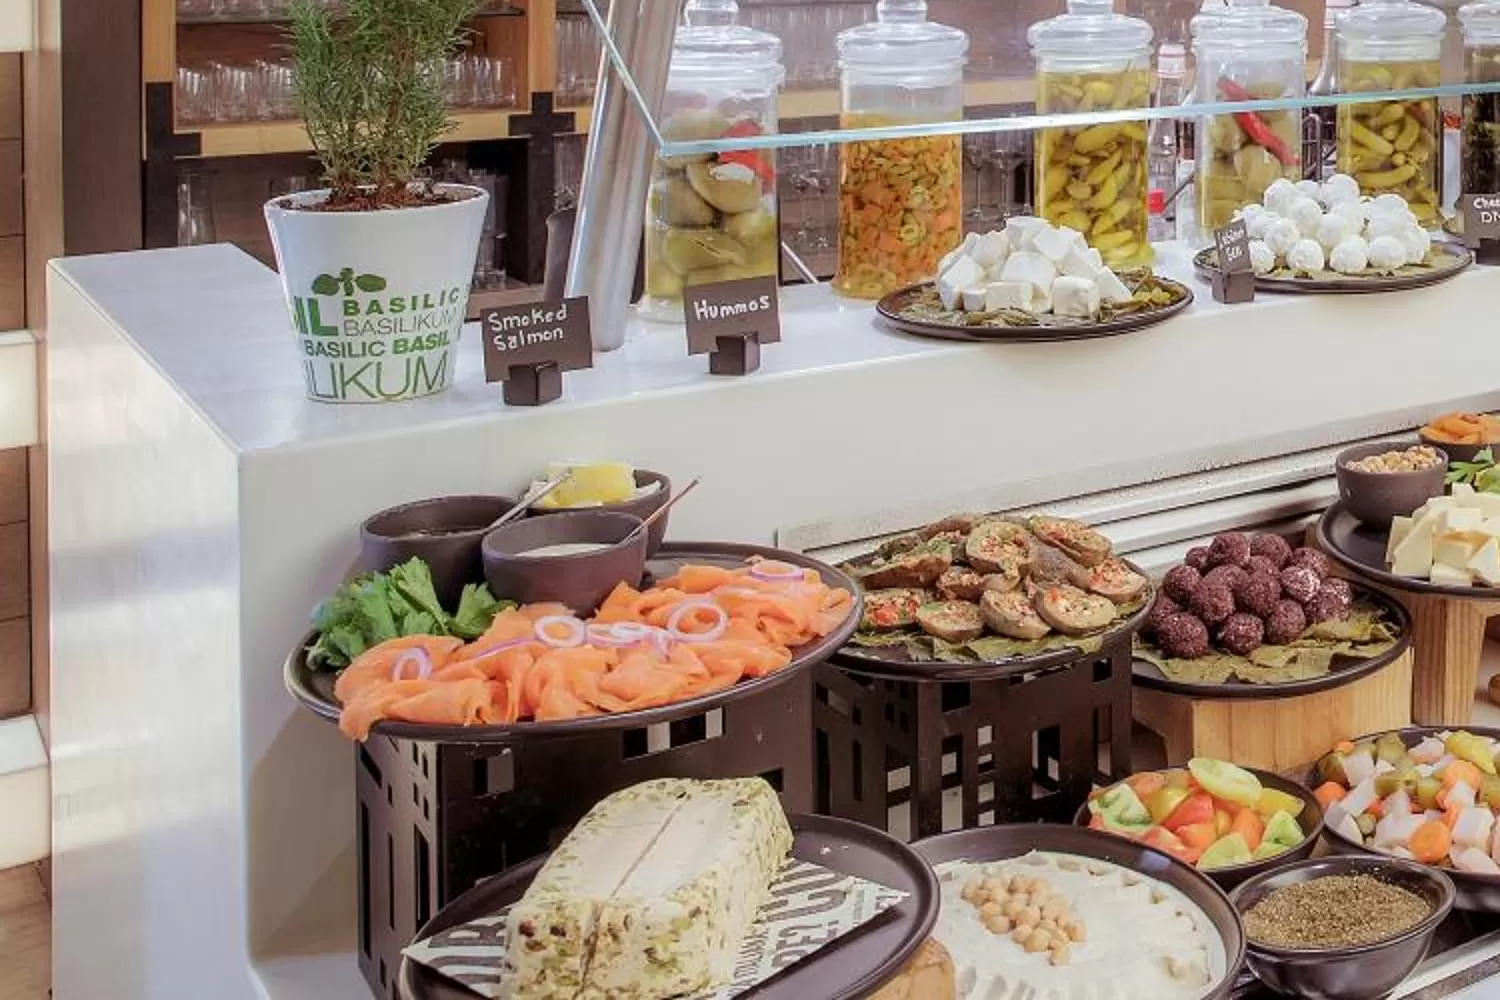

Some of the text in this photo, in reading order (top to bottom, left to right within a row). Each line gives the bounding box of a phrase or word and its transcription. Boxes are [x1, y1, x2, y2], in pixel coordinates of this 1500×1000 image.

[342, 287, 460, 317] BASILIC
[692, 294, 770, 321] Hummos
[487, 303, 568, 332] Smoked
[303, 330, 450, 359] BASILIC BASIL
[493, 327, 564, 352] Salmon
